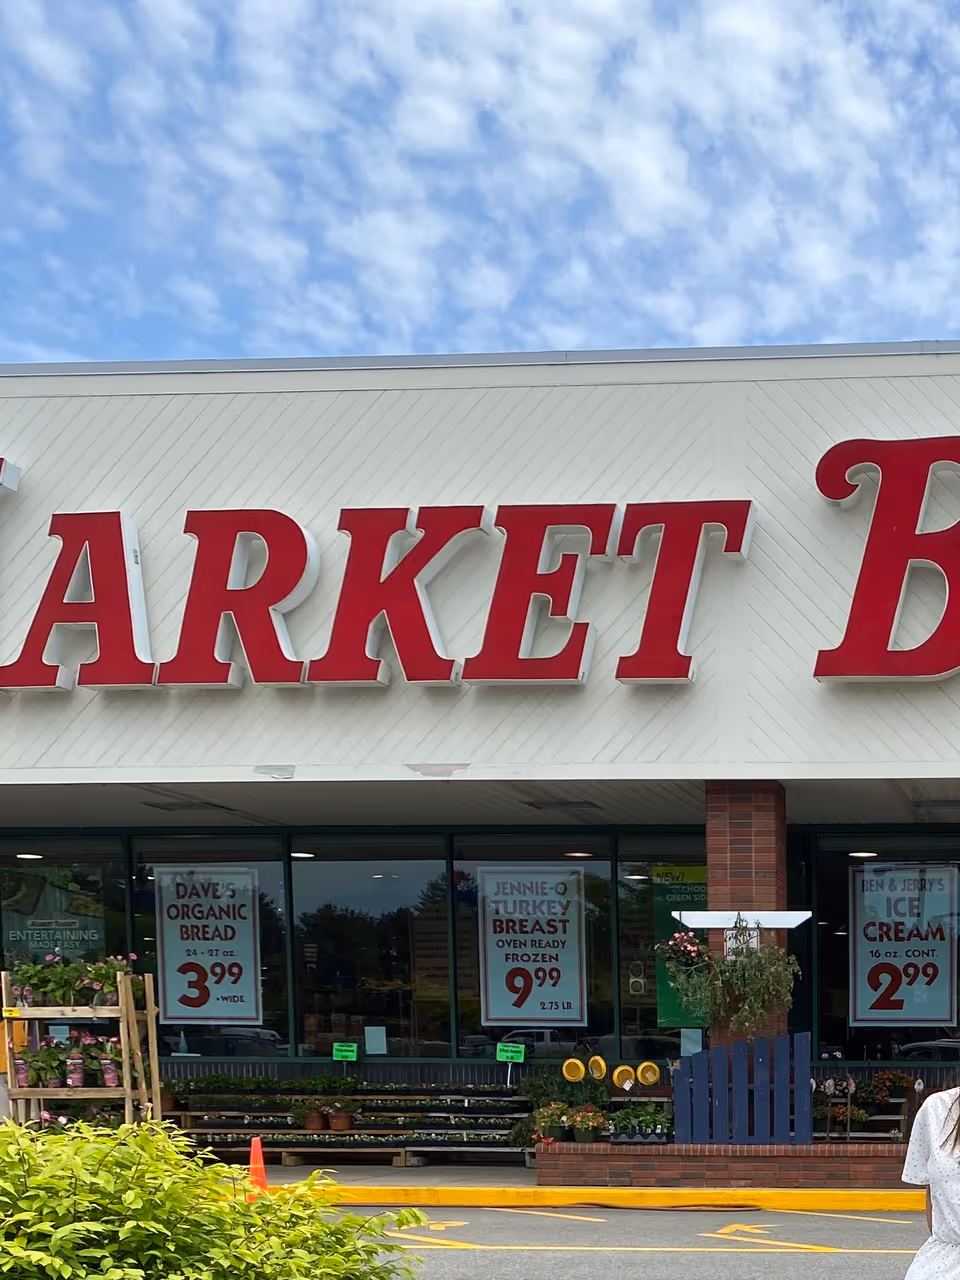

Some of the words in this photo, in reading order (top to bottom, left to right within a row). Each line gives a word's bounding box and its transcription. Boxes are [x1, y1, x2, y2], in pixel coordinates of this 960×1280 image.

[0, 499, 754, 688] ARKET
[175, 882, 236, 900] DAVE'S
[494, 881, 568, 897] JENNIE-O
[862, 879, 885, 893] BEN
[888, 878, 898, 892] &
[901, 878, 945, 893] JERRY'S
[166, 903, 248, 921] ORGANIC
[492, 899, 571, 916] TURKEY
[886, 896, 922, 918] ICE
[180, 924, 236, 941] BREAD
[492, 918, 570, 935] BREAST
[863, 921, 946, 943] CREAM
[9, 930, 99, 941] ENTERTAINING
[29, 941, 54, 949] MADE
[496, 939, 527, 949] OVEN
[530, 939, 567, 949] READY
[505, 953, 559, 963] FROZEN
[869, 949, 881, 958] 16
[905, 949, 939, 958] CONT.
[540, 1001, 559, 1010] 2.75
